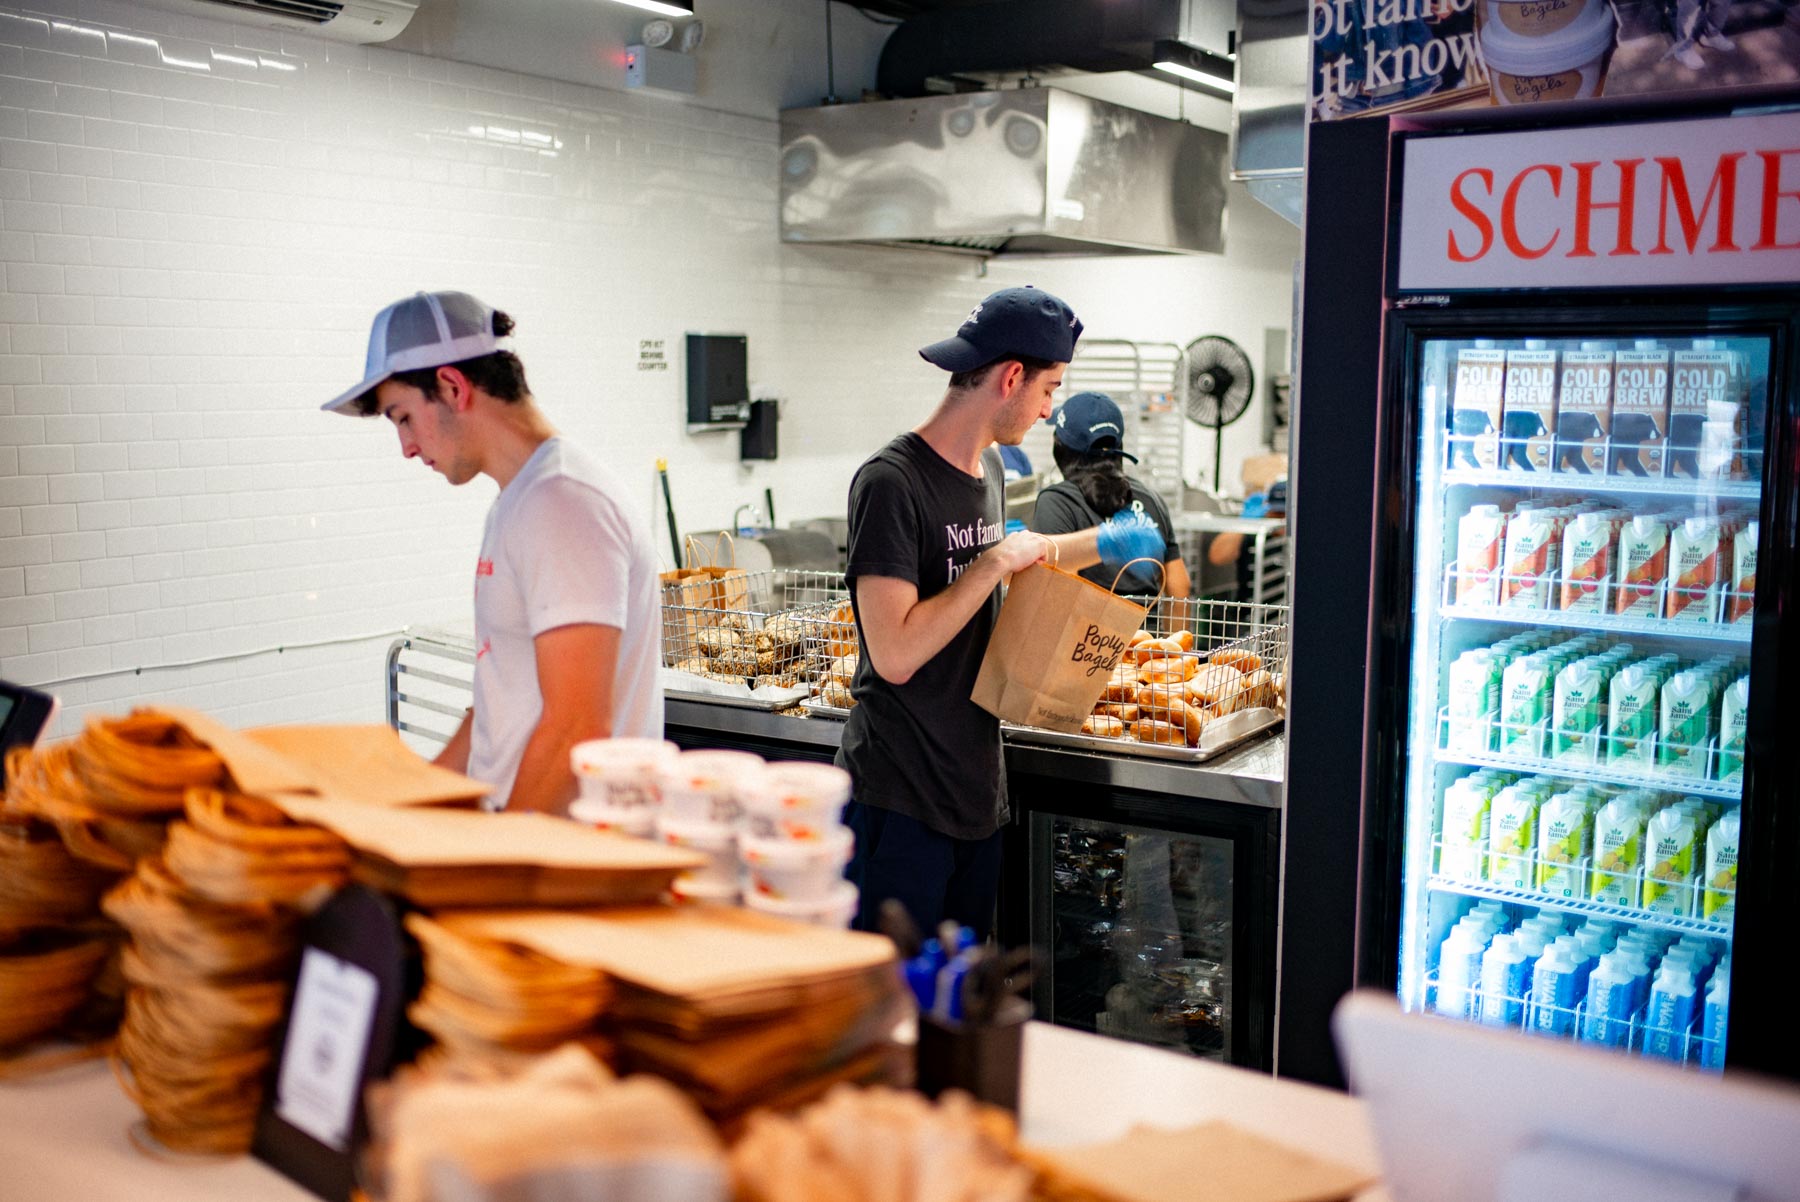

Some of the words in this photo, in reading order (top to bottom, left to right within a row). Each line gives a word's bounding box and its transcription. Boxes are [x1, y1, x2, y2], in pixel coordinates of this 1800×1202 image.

[1459, 366, 1502, 385] COLD
[1508, 367, 1554, 386] COLD
[1562, 368, 1611, 388] COLD
[1617, 369, 1667, 388] COLD
[1674, 368, 1726, 388] COLD
[1508, 386, 1553, 403] BREW
[1562, 387, 1610, 404] BREW
[1616, 388, 1666, 405] BREW
[945, 523, 975, 551] Not
[1671, 706, 1693, 714] Saint
[1657, 842, 1678, 850] Saint
